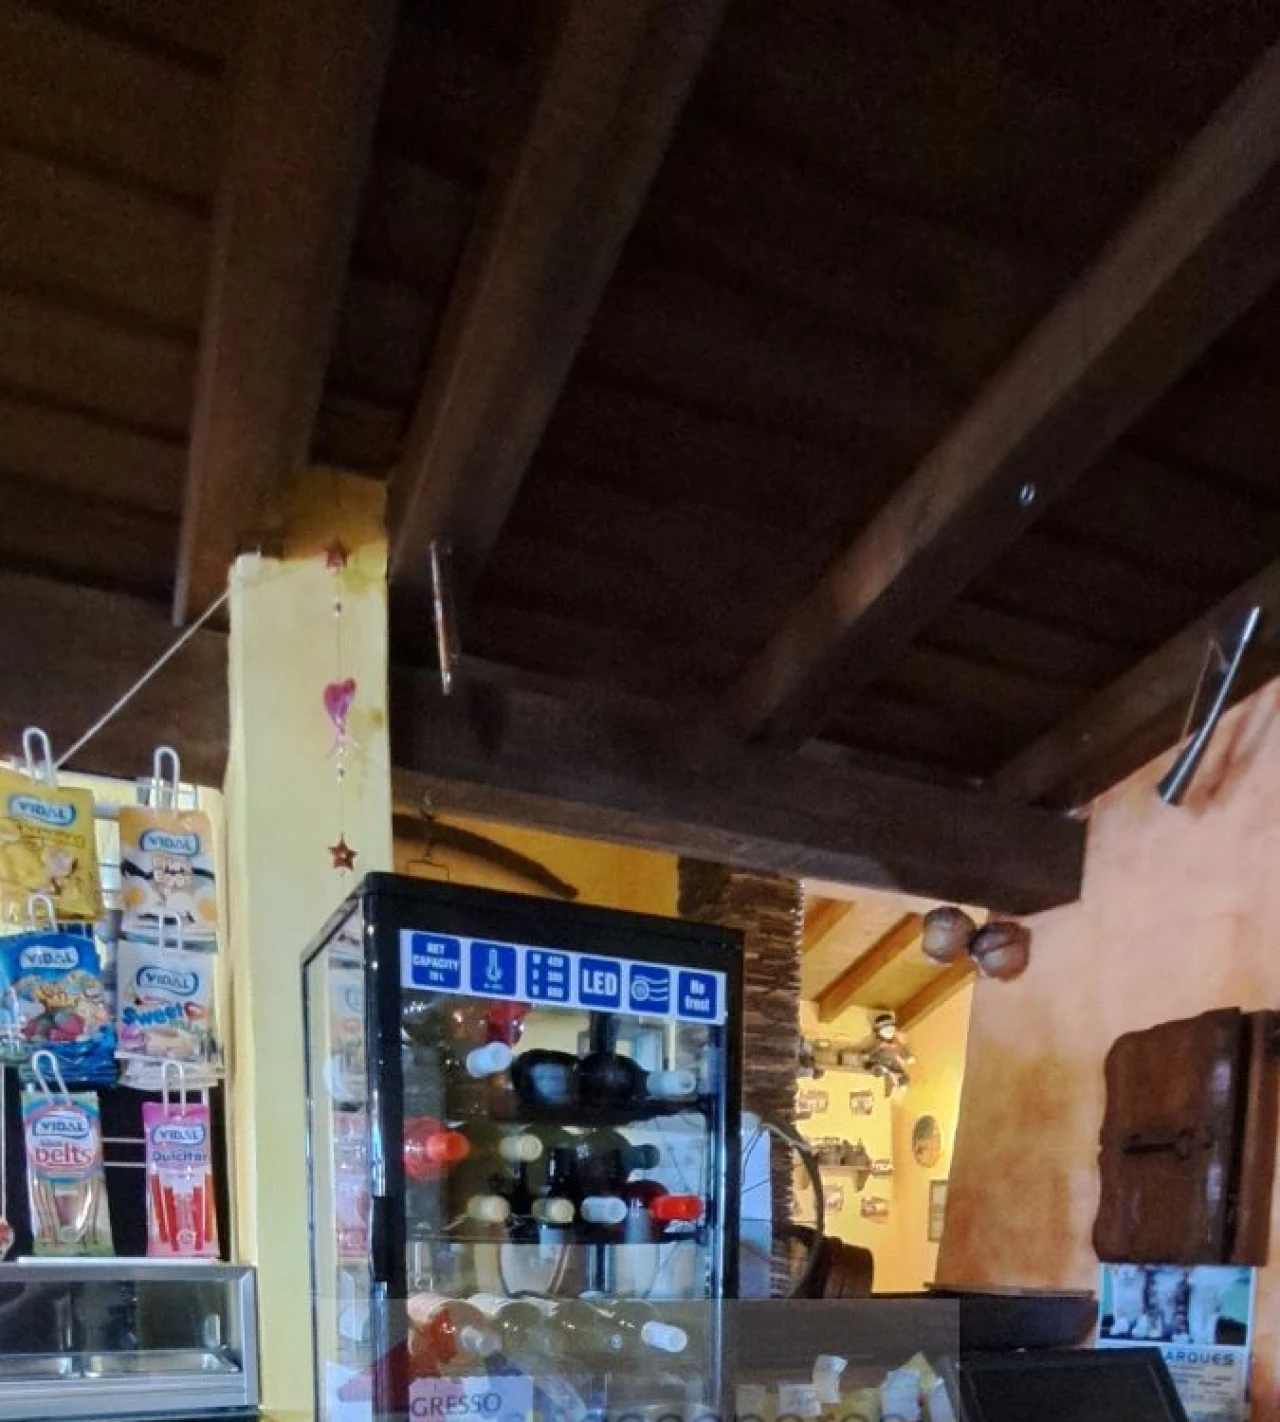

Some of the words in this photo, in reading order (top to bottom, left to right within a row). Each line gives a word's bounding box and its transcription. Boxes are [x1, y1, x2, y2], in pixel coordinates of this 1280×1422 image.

[18, 803, 66, 820] VIDAL
[149, 836, 192, 851] VIDAL
[26, 952, 76, 965] VIDAL
[412, 954, 458, 972] CAPACITY
[145, 971, 190, 990] VIDAL
[582, 969, 617, 996] LED
[689, 979, 706, 995] No
[684, 995, 710, 1012] frost
[41, 1121, 84, 1133] VIDAL
[159, 1129, 199, 1140] VIDAL
